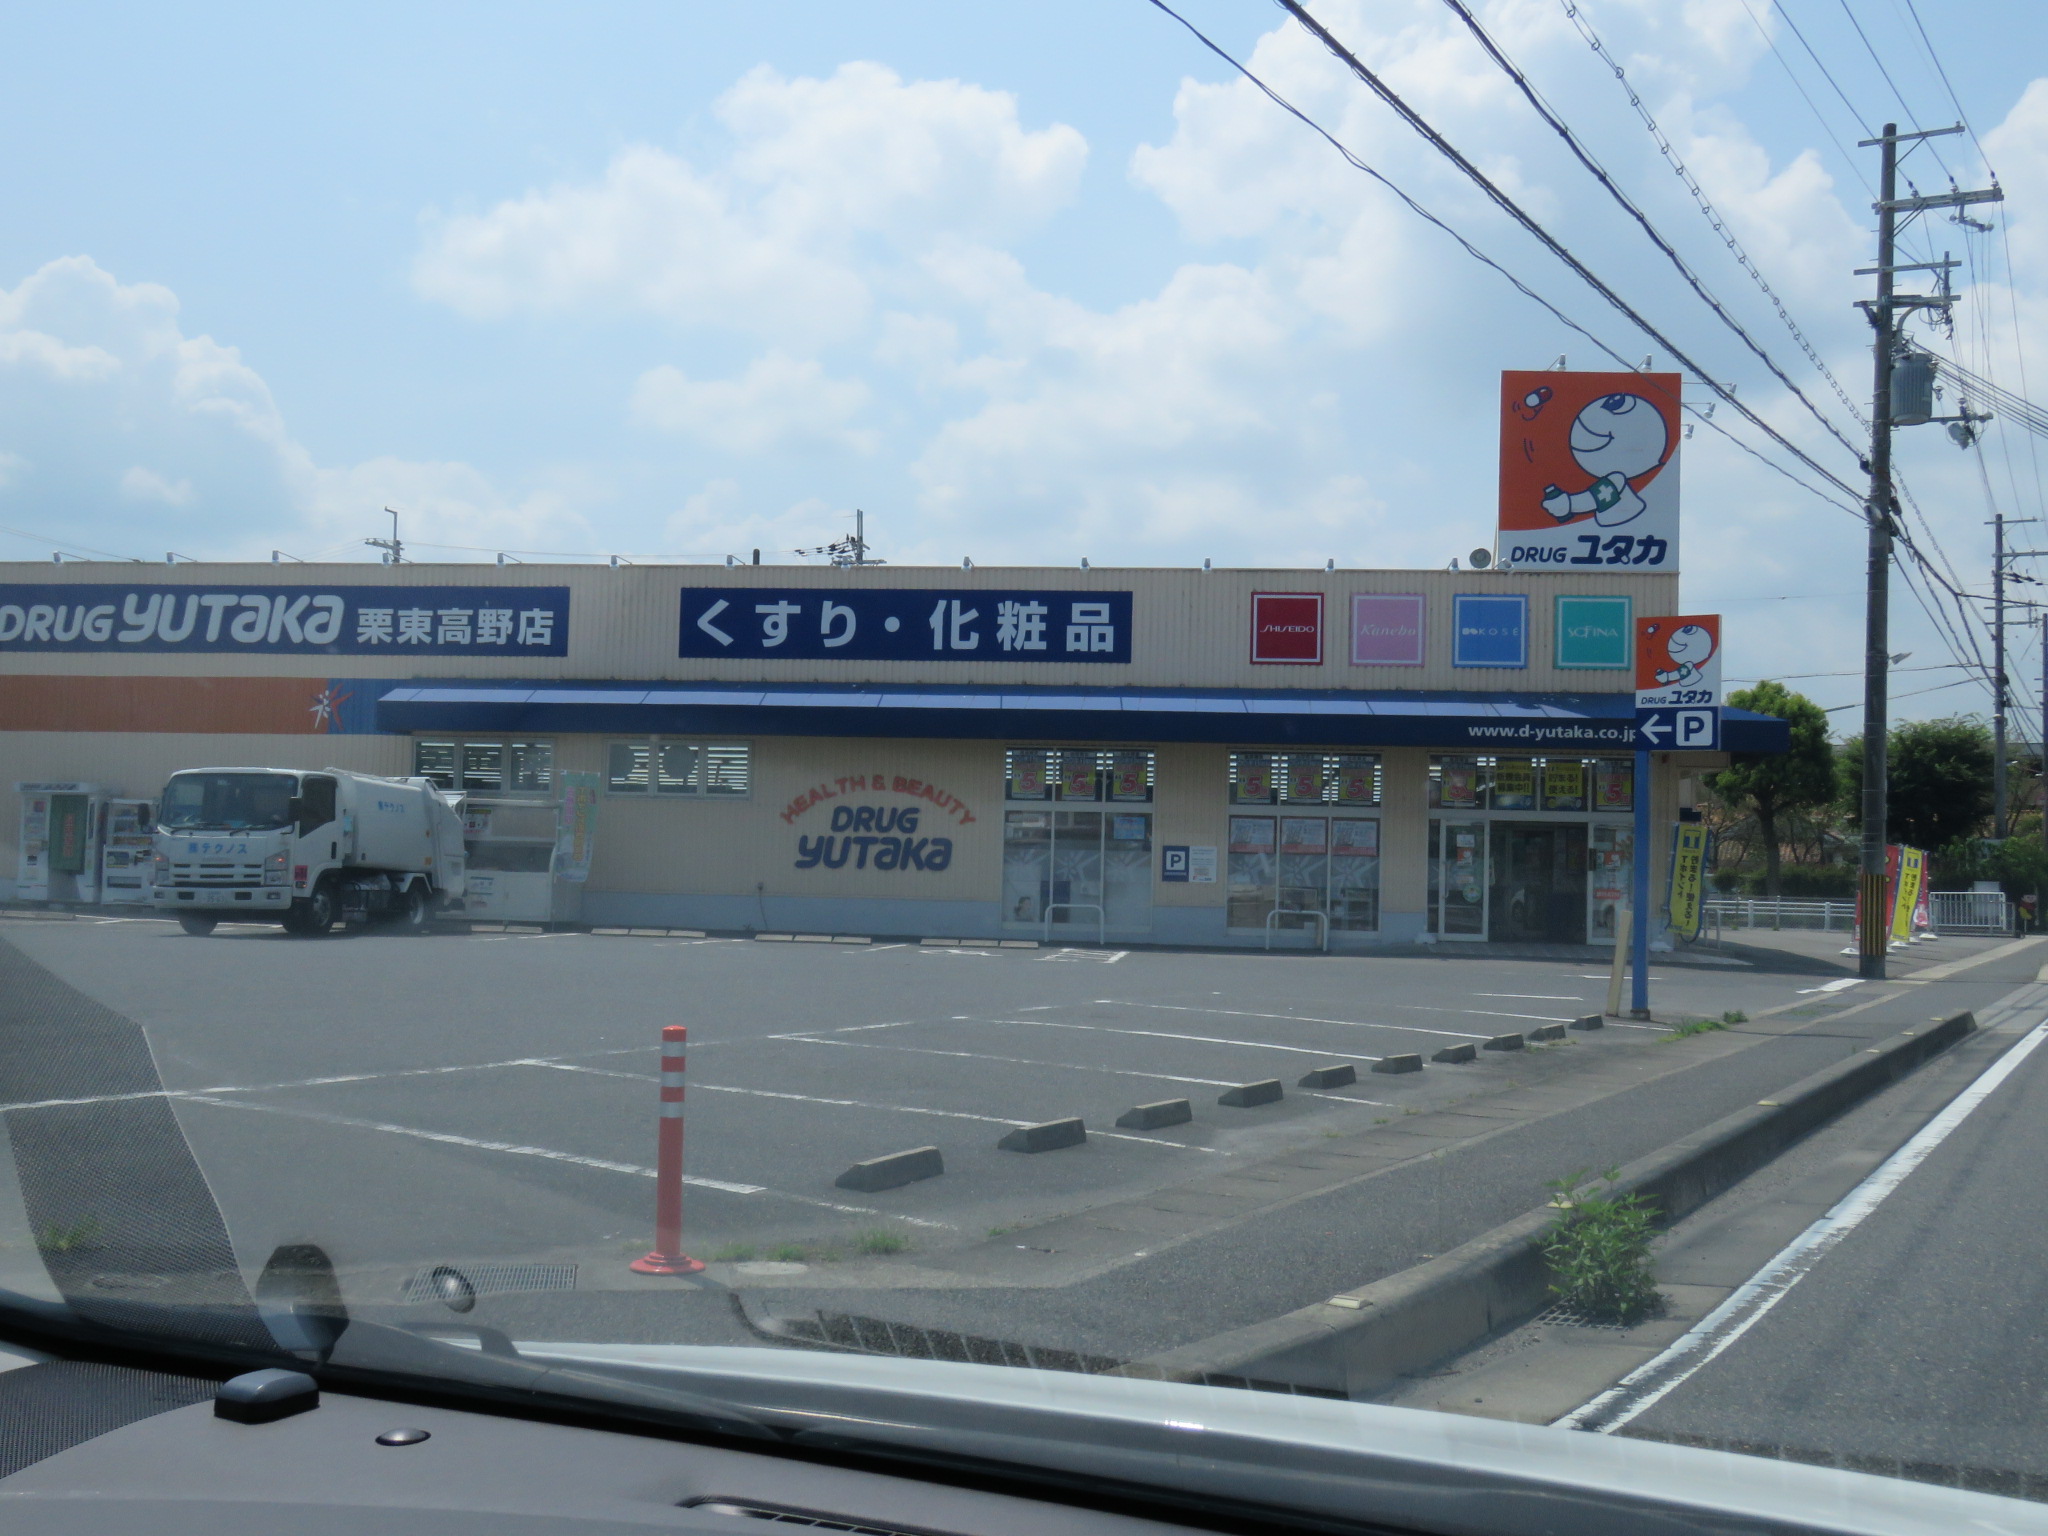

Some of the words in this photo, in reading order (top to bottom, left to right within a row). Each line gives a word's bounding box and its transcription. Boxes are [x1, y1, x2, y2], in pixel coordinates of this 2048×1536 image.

[1511, 547, 1567, 563] DRUG
[1570, 534, 1667, 565] ユタカ
[0, 604, 116, 642] DRUG
[356, 608, 554, 645] 栗東高野店
[697, 599, 1114, 653] くすり・化粧品
[1259, 624, 1315, 633] SHISEIDO
[1360, 624, 1416, 635] Kanebo
[1567, 627, 1618, 639] SOFINA
[1668, 690, 1713, 704] ユタカ
[1468, 724, 1637, 742] www.d-yutaka.co.jp
[1683, 716, 1705, 742] P
[780, 775, 866, 825] HEALTH
[871, 774, 886, 791] &
[892, 776, 976, 825] BEAUTY
[830, 805, 920, 834] DRUG
[1170, 853, 1182, 868] P
